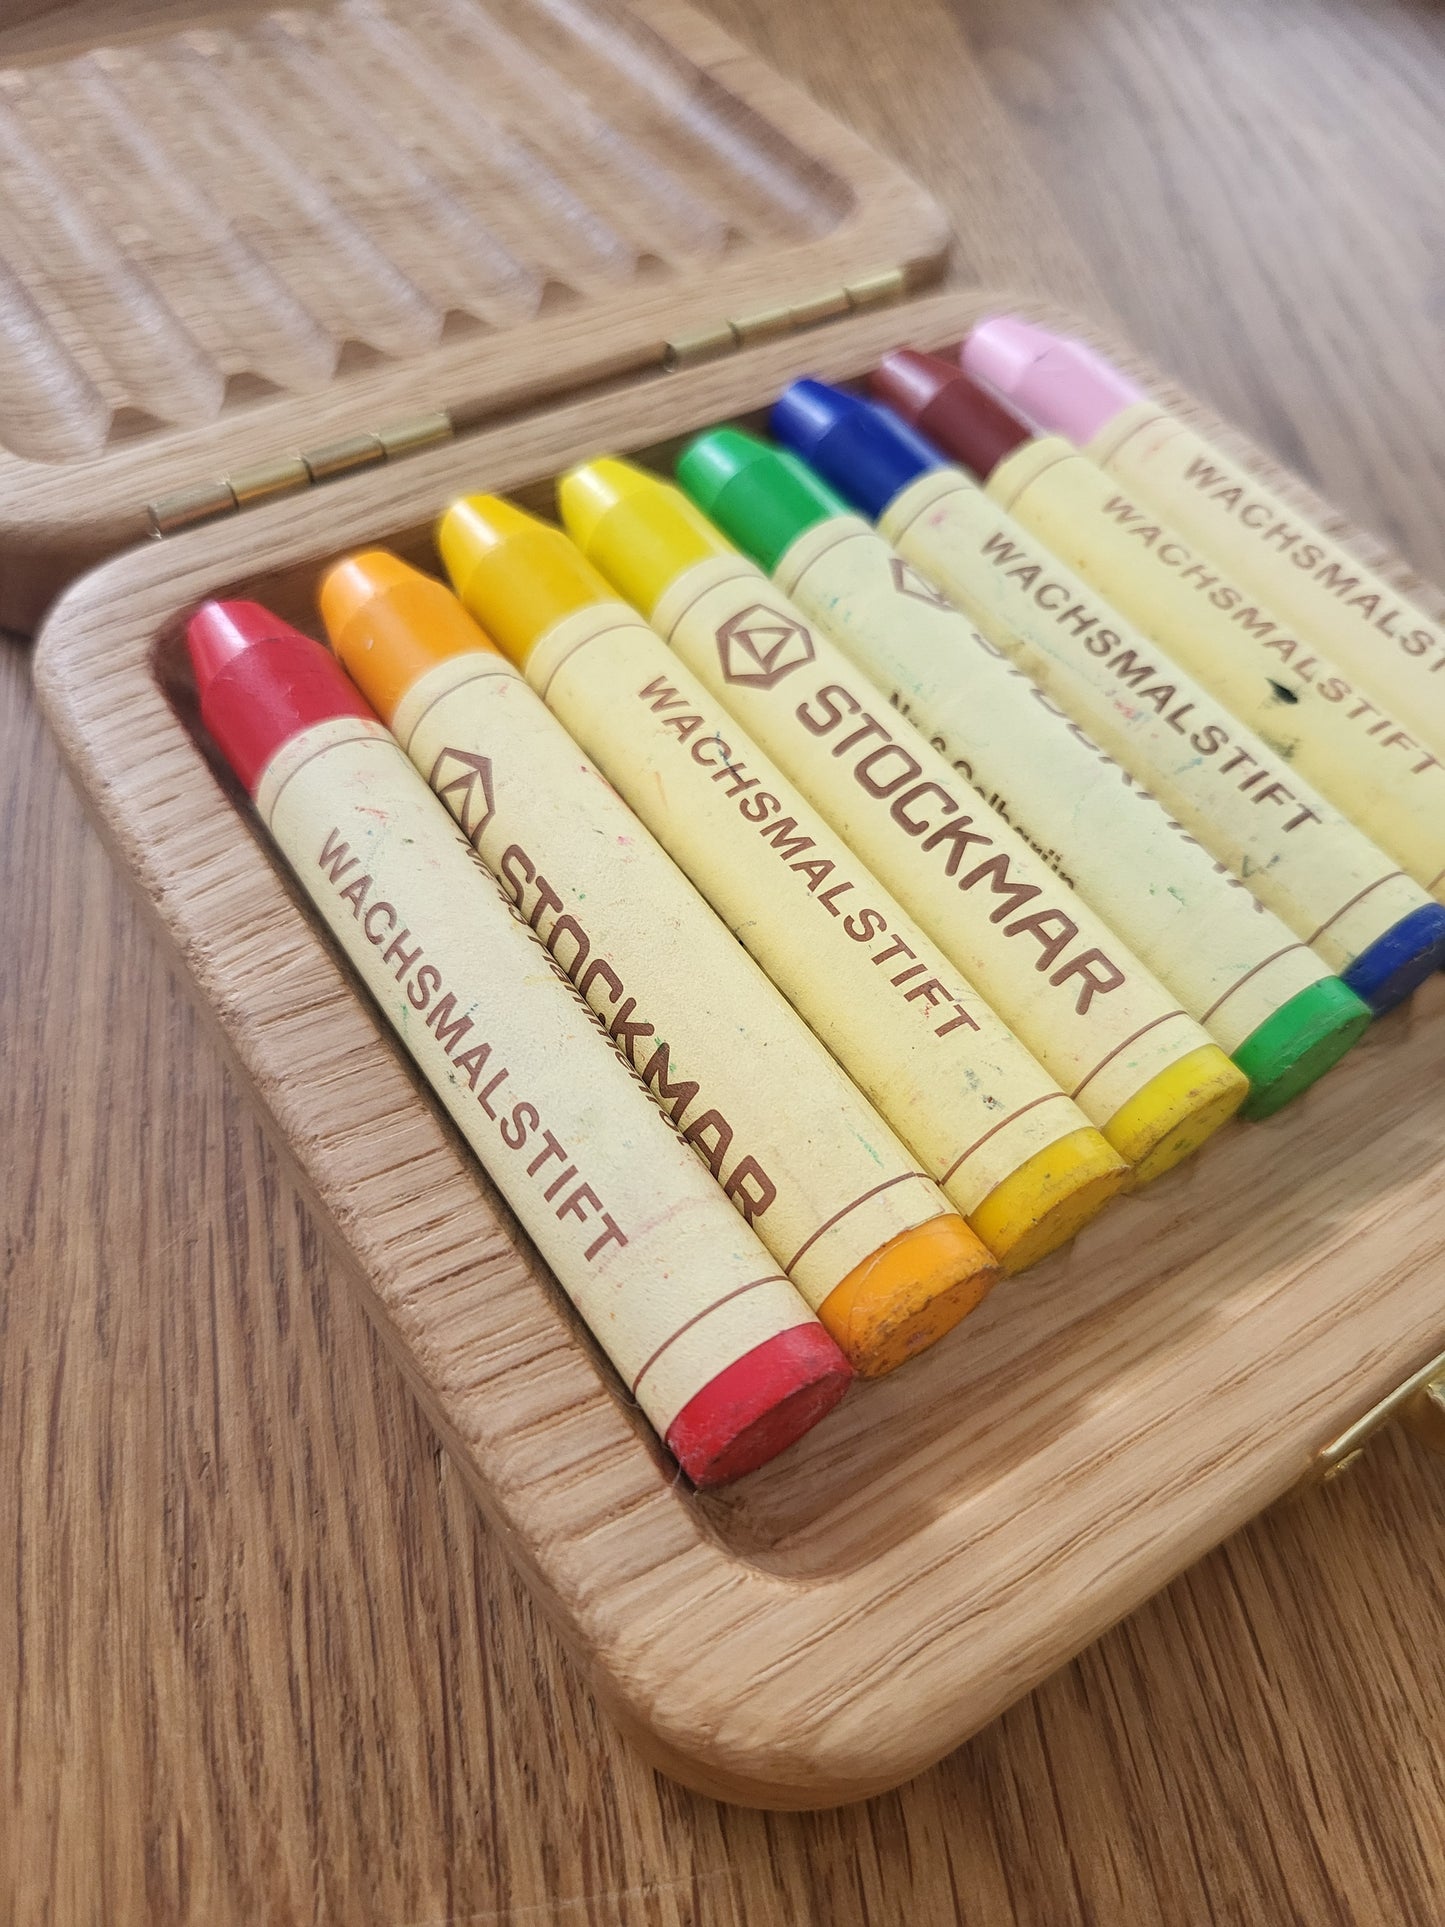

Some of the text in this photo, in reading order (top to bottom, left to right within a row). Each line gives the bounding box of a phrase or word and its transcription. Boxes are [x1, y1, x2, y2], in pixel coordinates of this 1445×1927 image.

[980, 531, 1322, 833] WACHSMALSTIFT
[1100, 495, 1445, 775] WACHSMALSTIFT
[638, 675, 981, 1038] WACHSMALSTIFT
[795, 685, 1126, 1015] STOCKMAR
[318, 827, 629, 1262] WACHSMALSTIFT
[501, 844, 776, 1228] STOCKMAR
